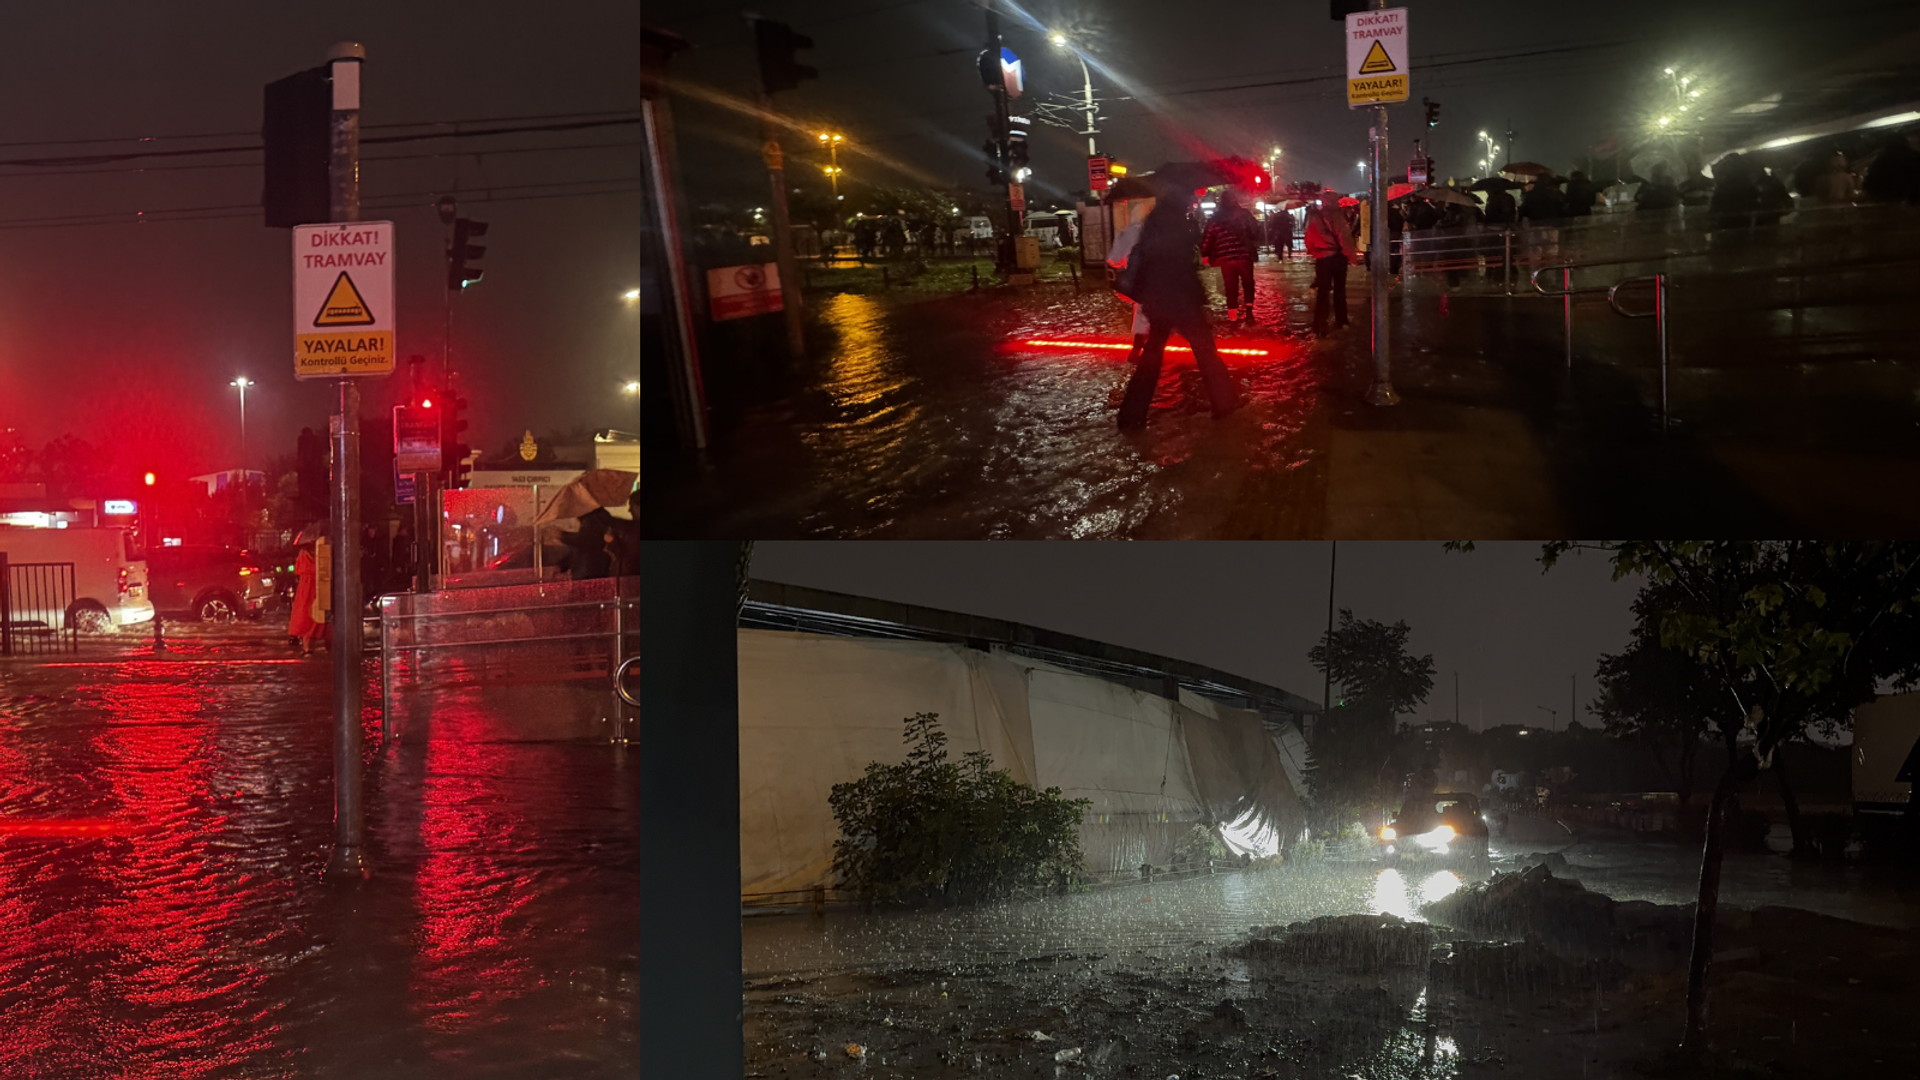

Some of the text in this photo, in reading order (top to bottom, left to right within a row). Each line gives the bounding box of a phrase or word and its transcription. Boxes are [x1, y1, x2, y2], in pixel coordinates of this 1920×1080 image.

[1357, 14, 1399, 26] DİKKAT!
[1353, 26, 1404, 39] TRAMVAY
[1353, 78, 1402, 91] YAYALAR!
[311, 230, 379, 247] DİKKAT!
[303, 251, 387, 268] TRAMVAY
[303, 338, 384, 353] YAYALAR!
[301, 355, 388, 366] Kontrollü Geçiniz.
